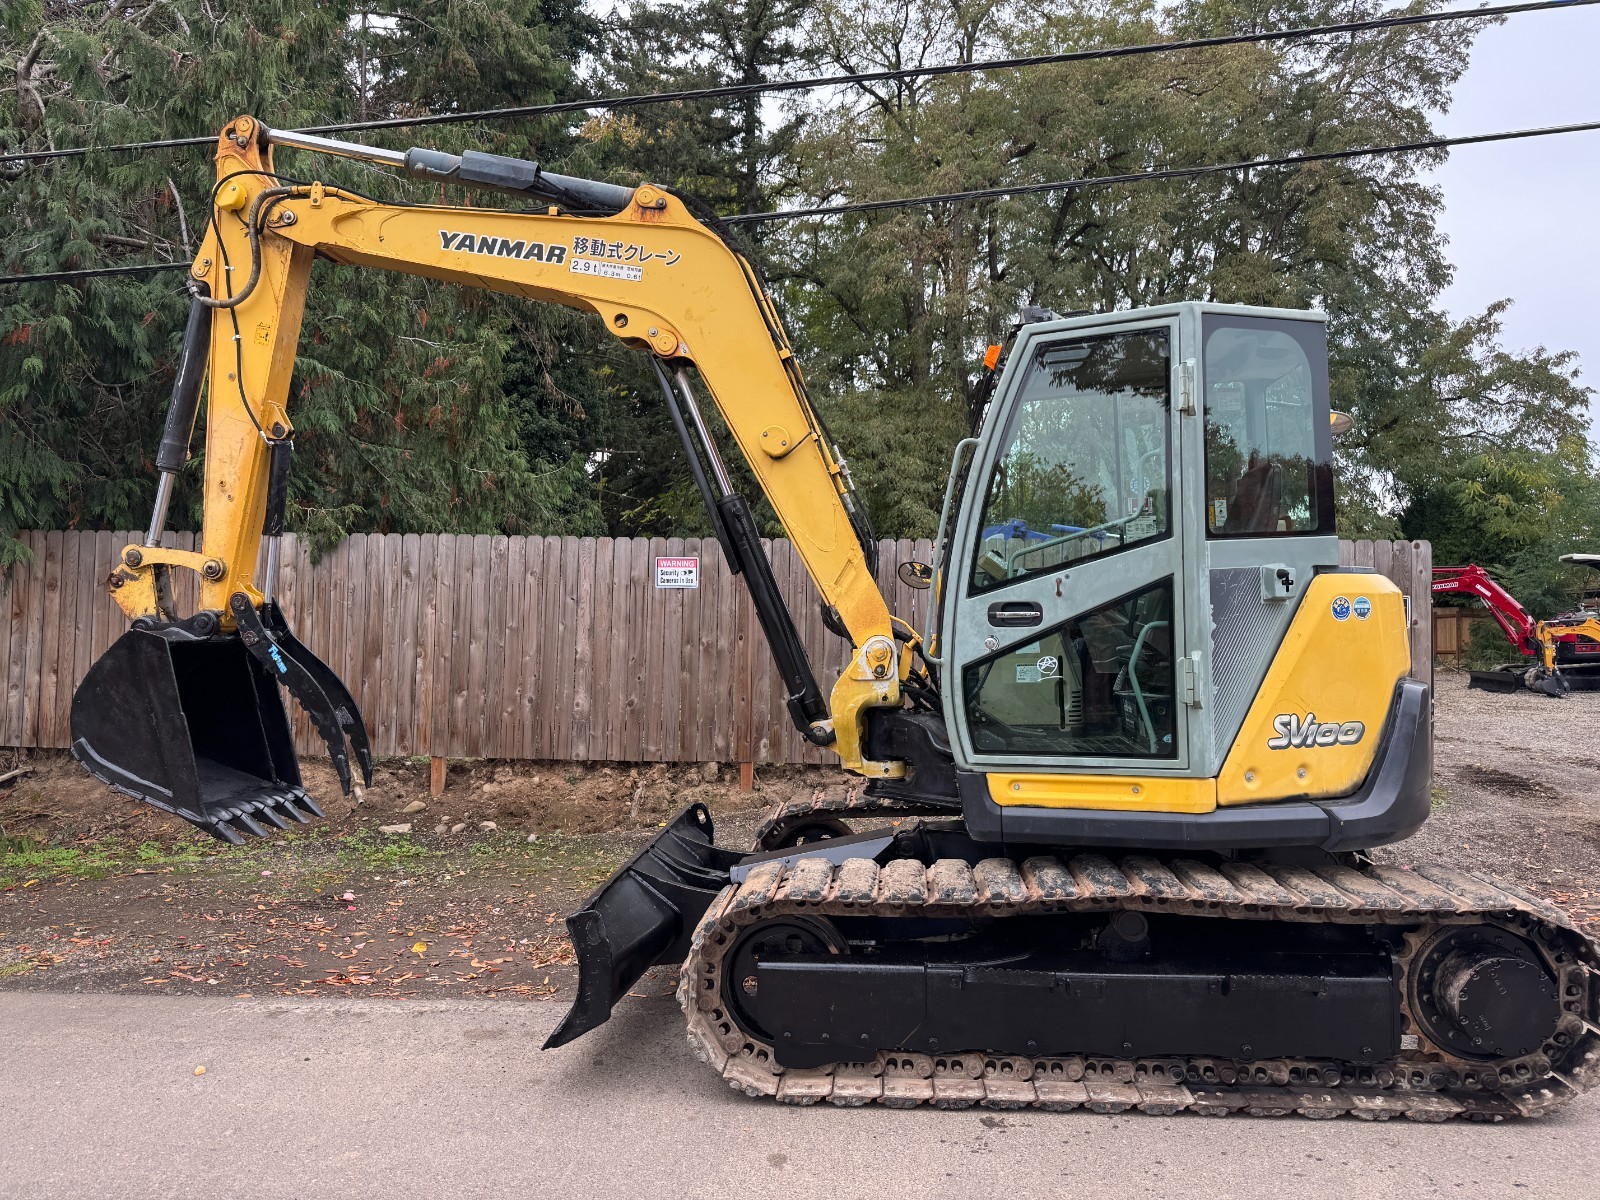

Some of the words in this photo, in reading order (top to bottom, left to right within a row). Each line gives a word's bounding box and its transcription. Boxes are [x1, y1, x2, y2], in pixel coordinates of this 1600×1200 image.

[439, 230, 567, 265] YANMAR
[572, 236, 681, 265] 移動式クレーン
[660, 569, 679, 577] Security
[1267, 711, 1366, 751] SV100
